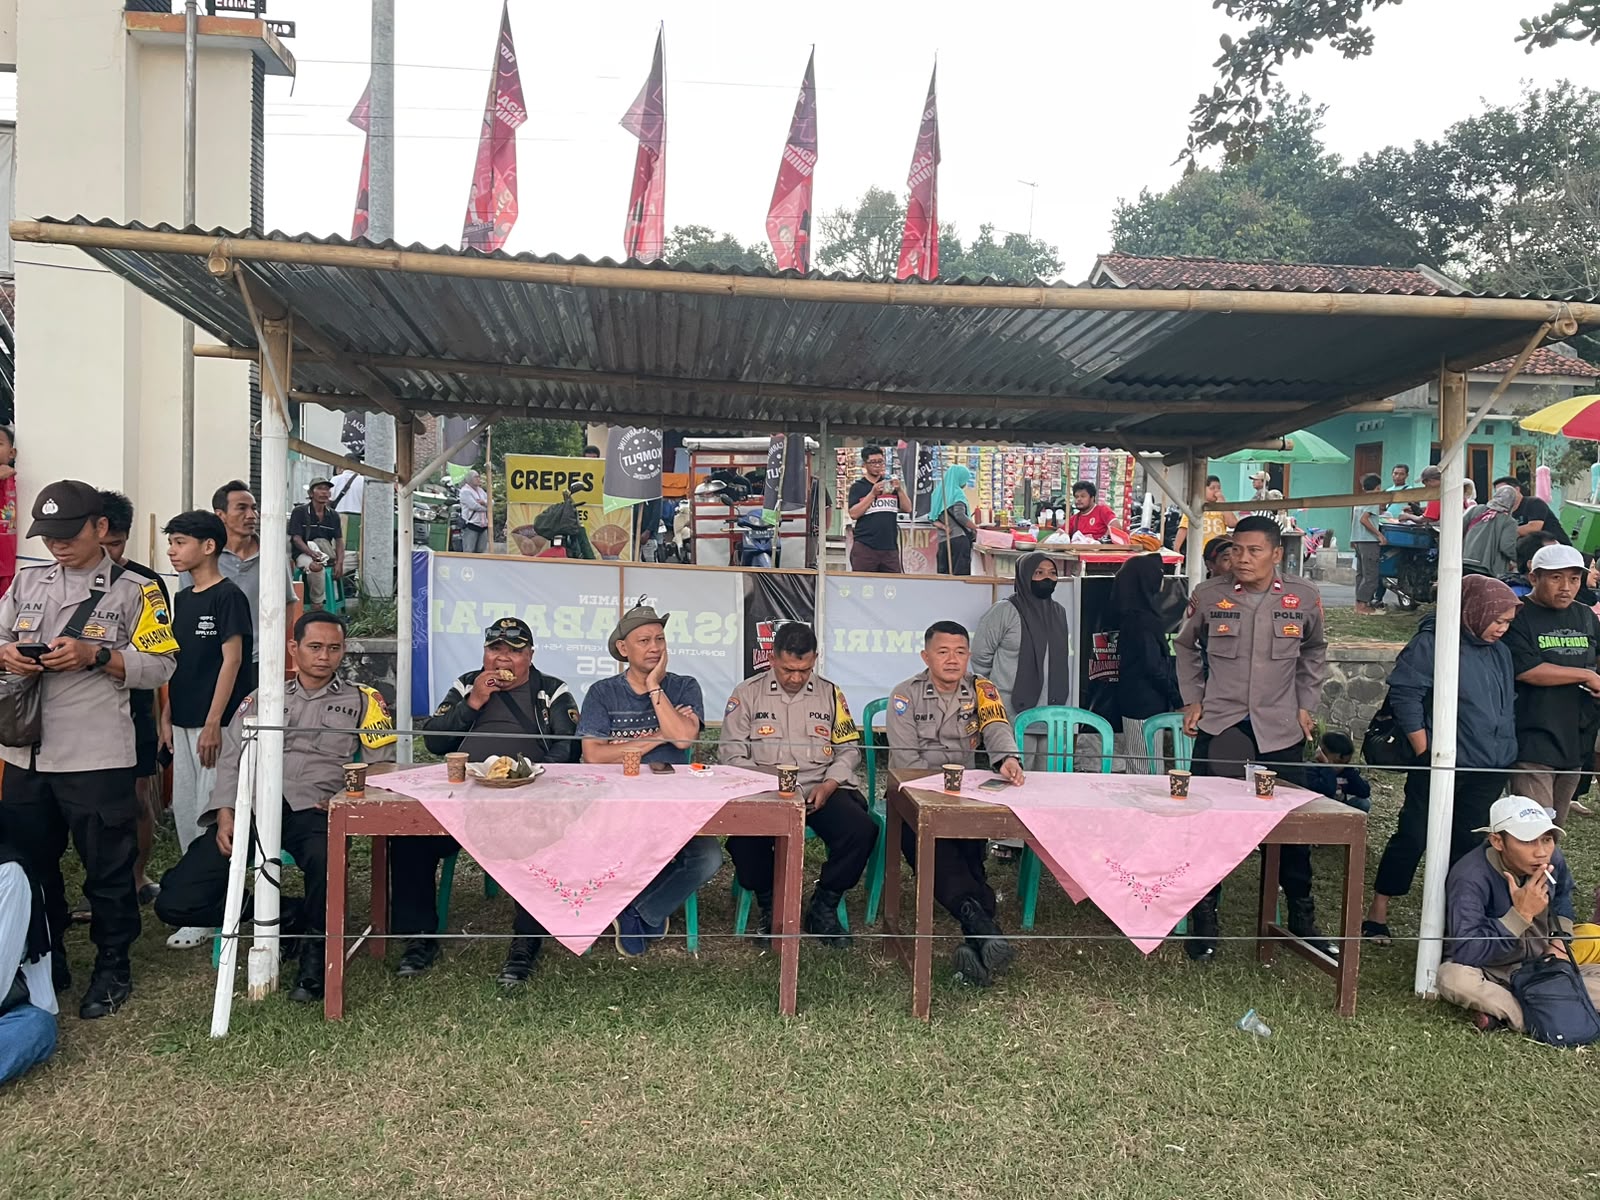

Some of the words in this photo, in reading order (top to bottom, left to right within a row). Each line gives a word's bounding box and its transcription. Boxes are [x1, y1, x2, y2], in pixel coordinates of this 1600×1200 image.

[510, 469, 594, 492] CREPES
[578, 510, 588, 520] ES
[89, 610, 120, 621] OLRI
[1274, 611, 1304, 620] POLRI
[327, 705, 358, 717] POLRI
[809, 711, 831, 720] POLRI
